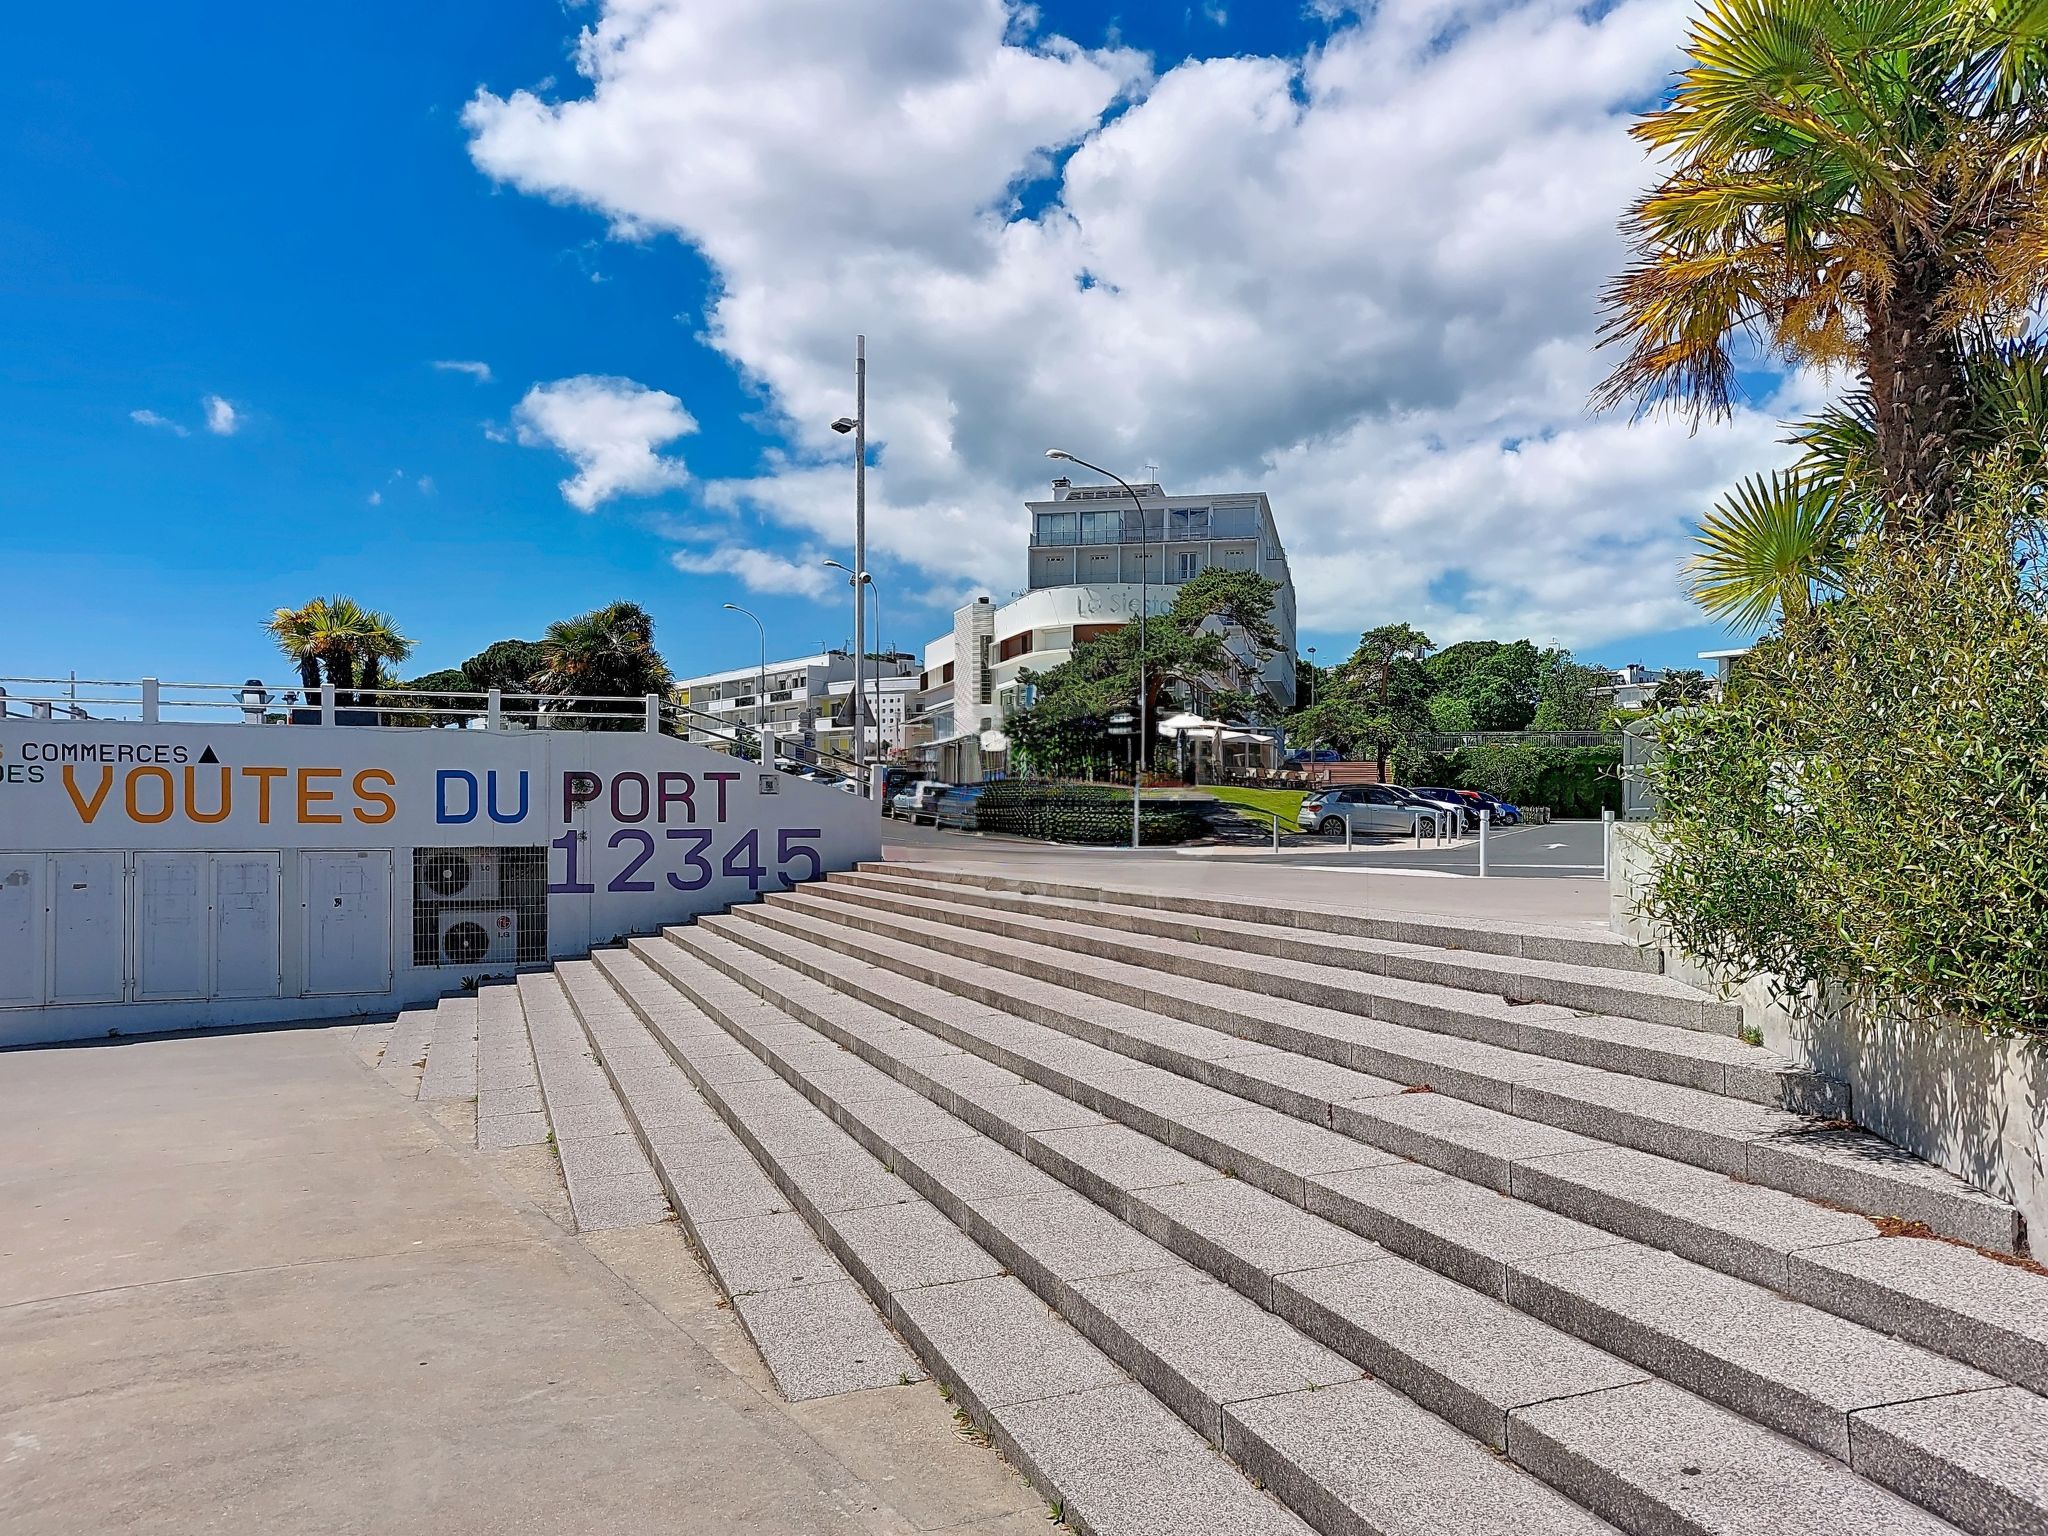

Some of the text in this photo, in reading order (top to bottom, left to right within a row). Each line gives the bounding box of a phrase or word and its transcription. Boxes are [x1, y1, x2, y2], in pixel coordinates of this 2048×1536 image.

[21, 742, 189, 763] COMMERCES
[62, 764, 397, 825] VOUTES
[435, 769, 529, 825] DU
[563, 771, 741, 823] PORT
[547, 828, 822, 893] 12345
